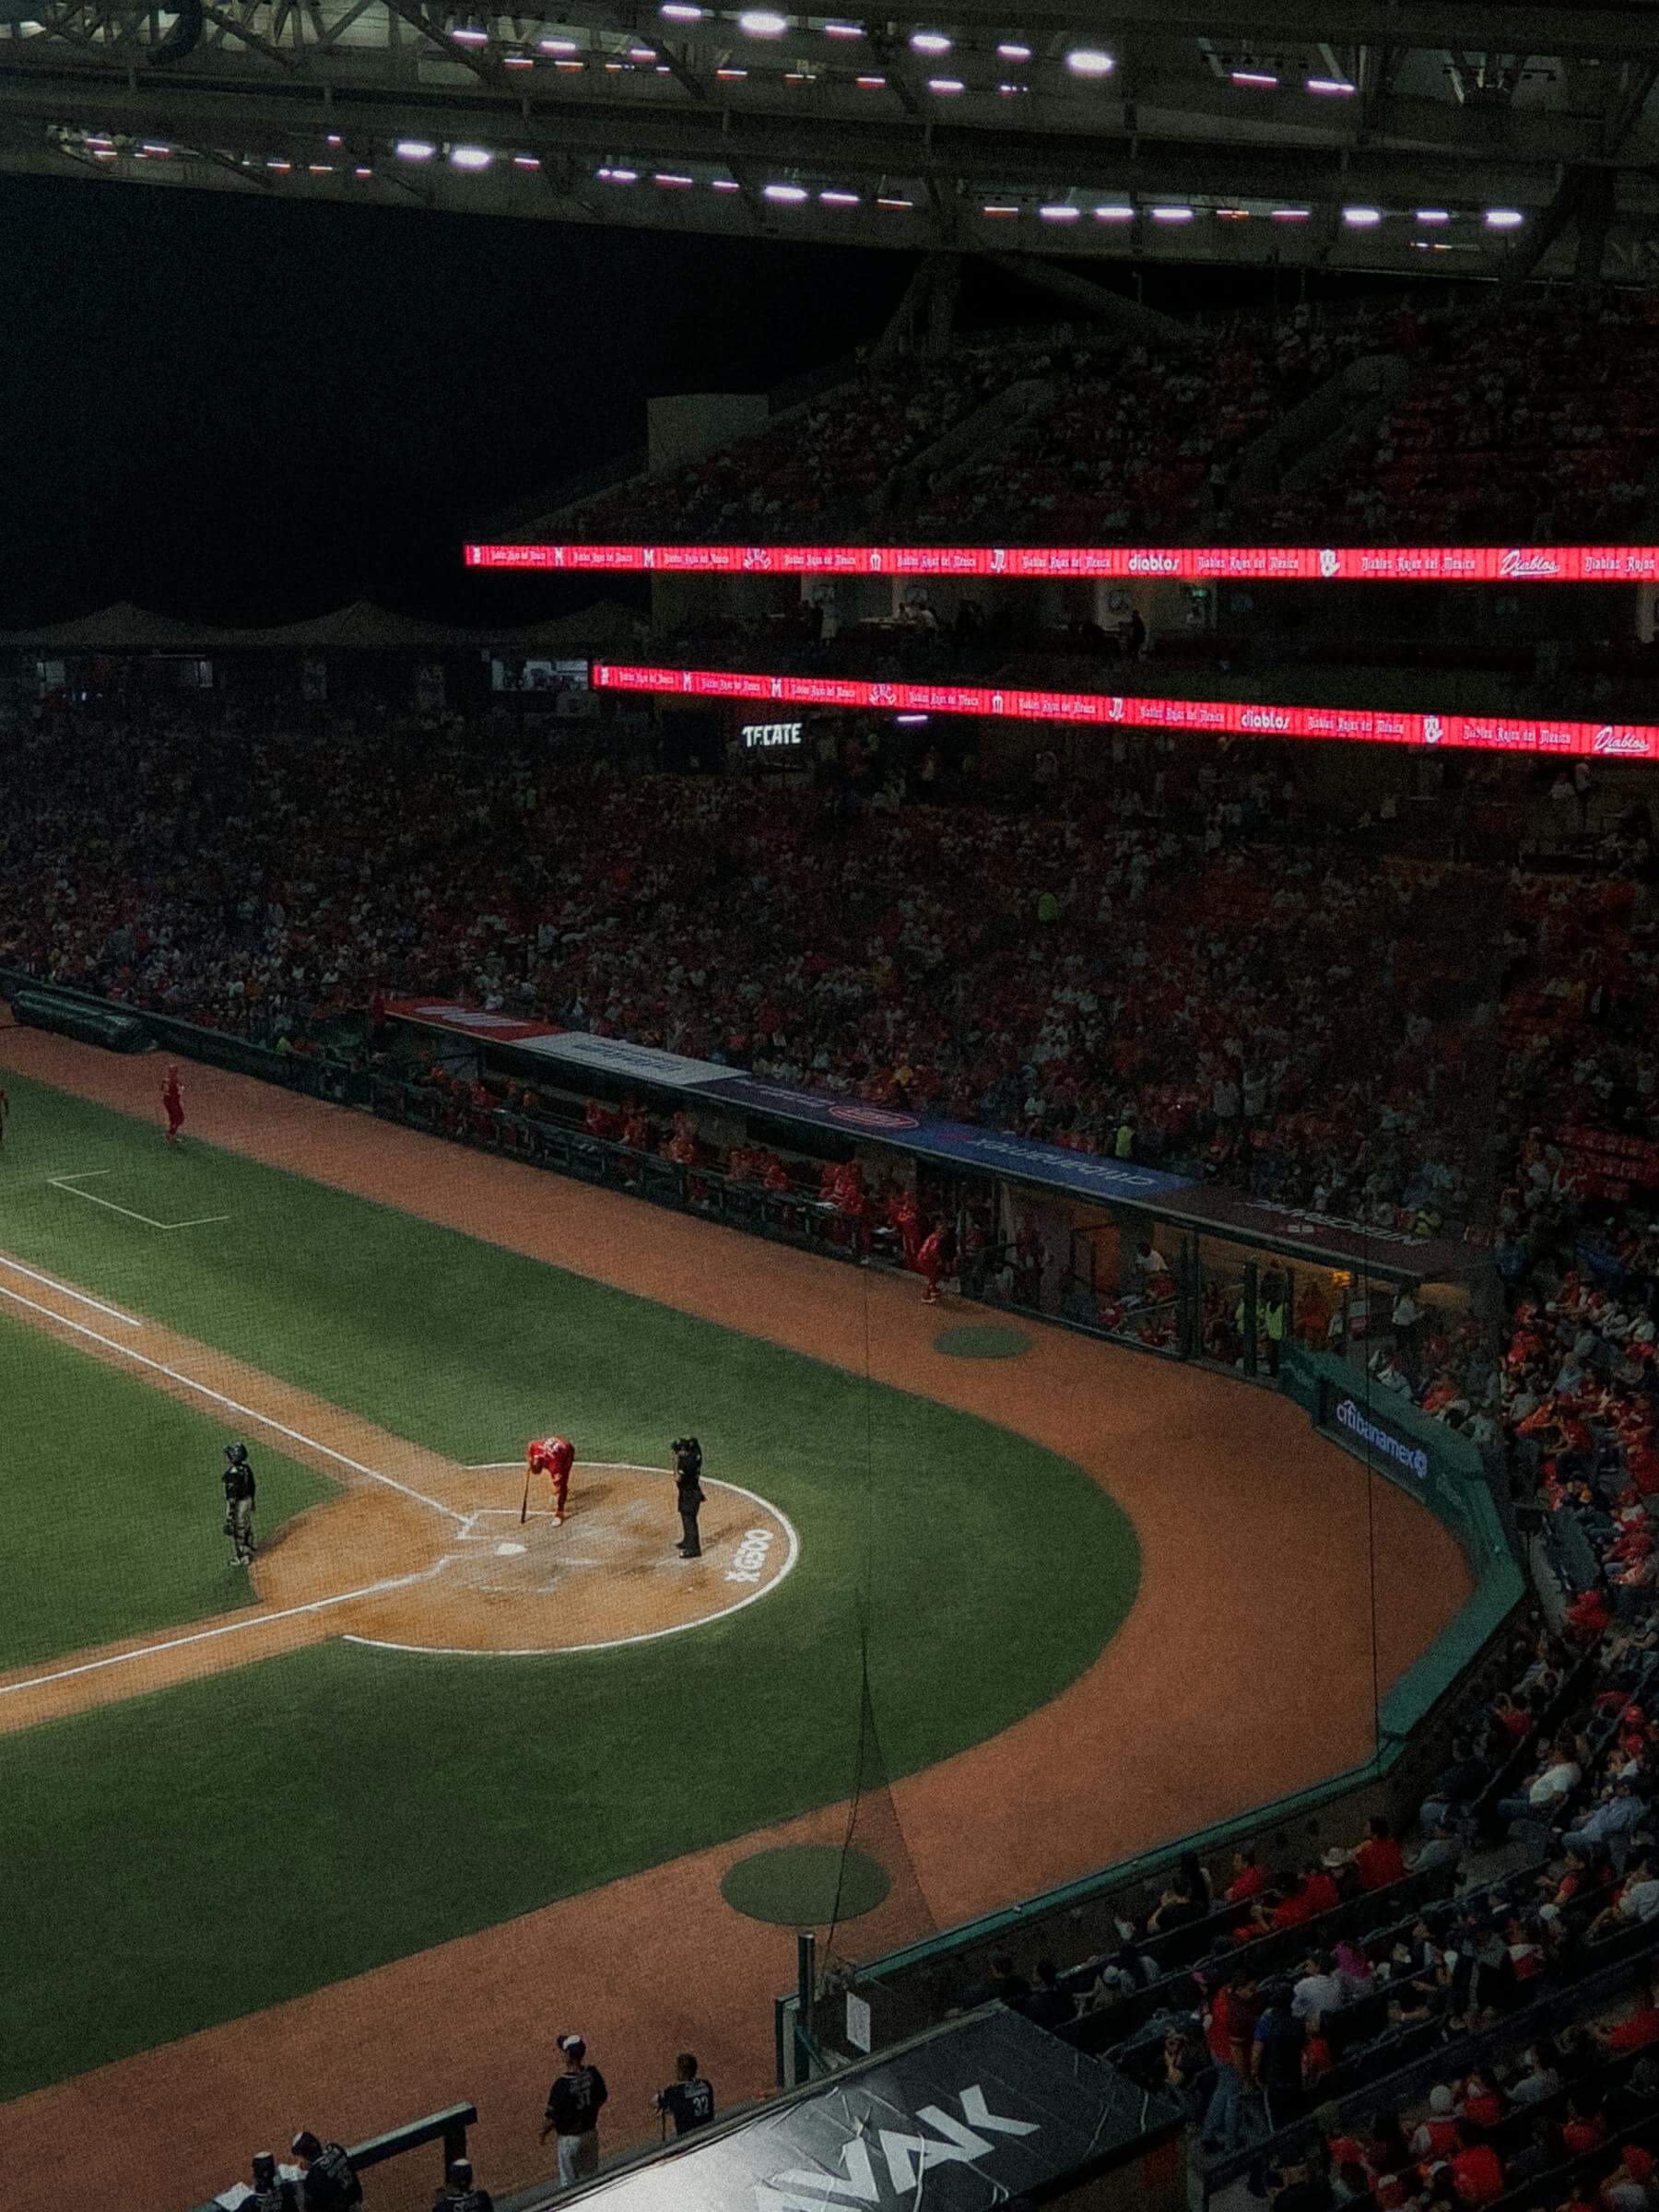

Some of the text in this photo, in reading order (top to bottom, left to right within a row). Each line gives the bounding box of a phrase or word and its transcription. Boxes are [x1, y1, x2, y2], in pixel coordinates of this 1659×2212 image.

[1128, 553, 1180, 571] diablos
[1500, 549, 1560, 577] Diablos
[1241, 710, 1289, 729] diablos
[1336, 1399, 1415, 1470] citibanamex
